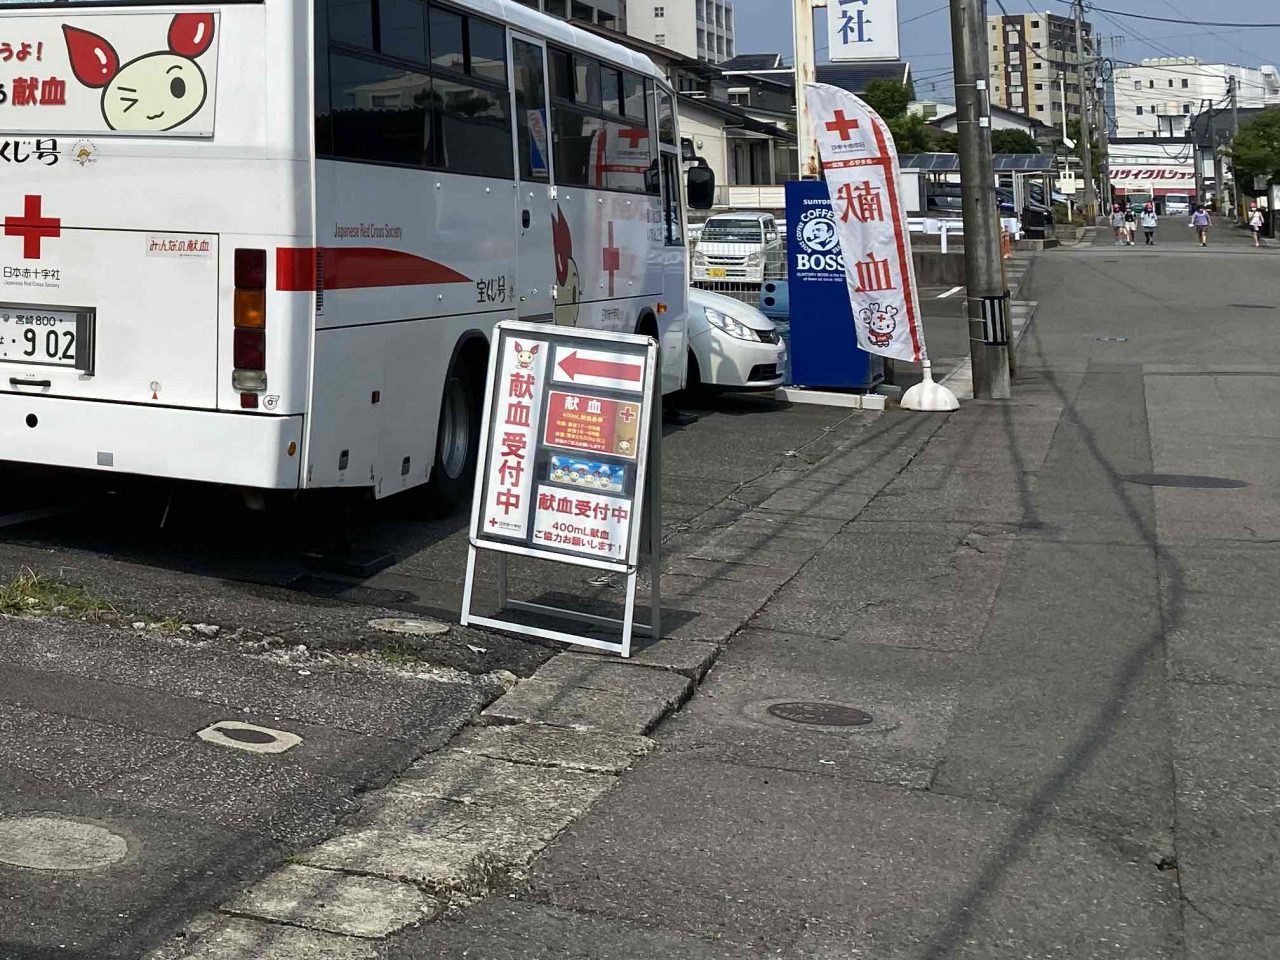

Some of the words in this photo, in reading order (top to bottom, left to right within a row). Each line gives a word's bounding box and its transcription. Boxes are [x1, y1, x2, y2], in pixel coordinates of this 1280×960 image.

[1110, 169, 1196, 179] リサイクルショッ
[800, 209, 834, 221] COFFE
[334, 223, 359, 240] Japanese
[360, 224, 370, 238] Red
[371, 224, 384, 239] Cross
[385, 224, 402, 240] Society
[149, 240, 210, 252] みんなの献血
[796, 254, 845, 270] BOSS
[3, 267, 61, 280] 日本赤十字社
[564, 396, 601, 414] 献血
[496, 371, 535, 515] 献血受付中
[538, 492, 628, 524] 献血受付中
